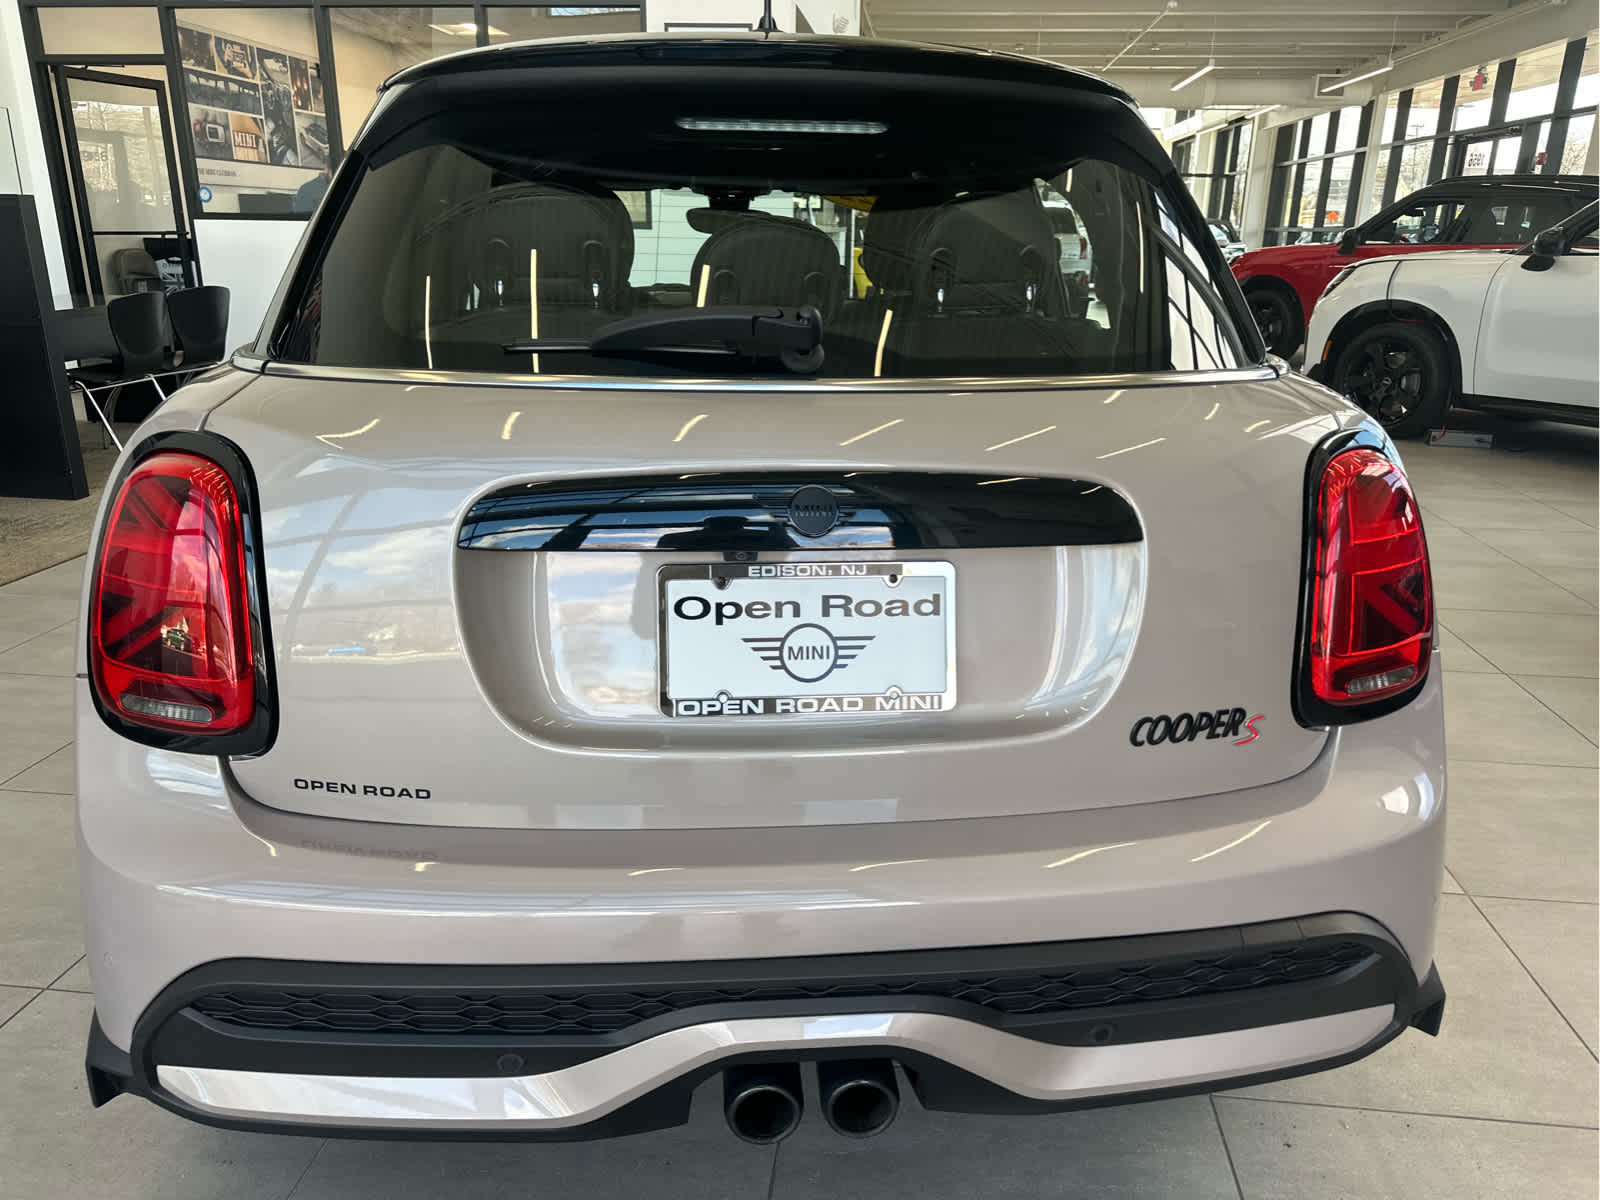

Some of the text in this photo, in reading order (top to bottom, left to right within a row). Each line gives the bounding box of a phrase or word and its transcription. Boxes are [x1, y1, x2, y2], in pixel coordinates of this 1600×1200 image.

[840, 565, 867, 576] NJ
[674, 593, 941, 625] Open Road
[787, 645, 831, 661] MINI
[678, 695, 940, 715] OPEN ROAD MINI
[1129, 707, 1247, 747] COOPER
[294, 778, 431, 800] OPEN ROAD
